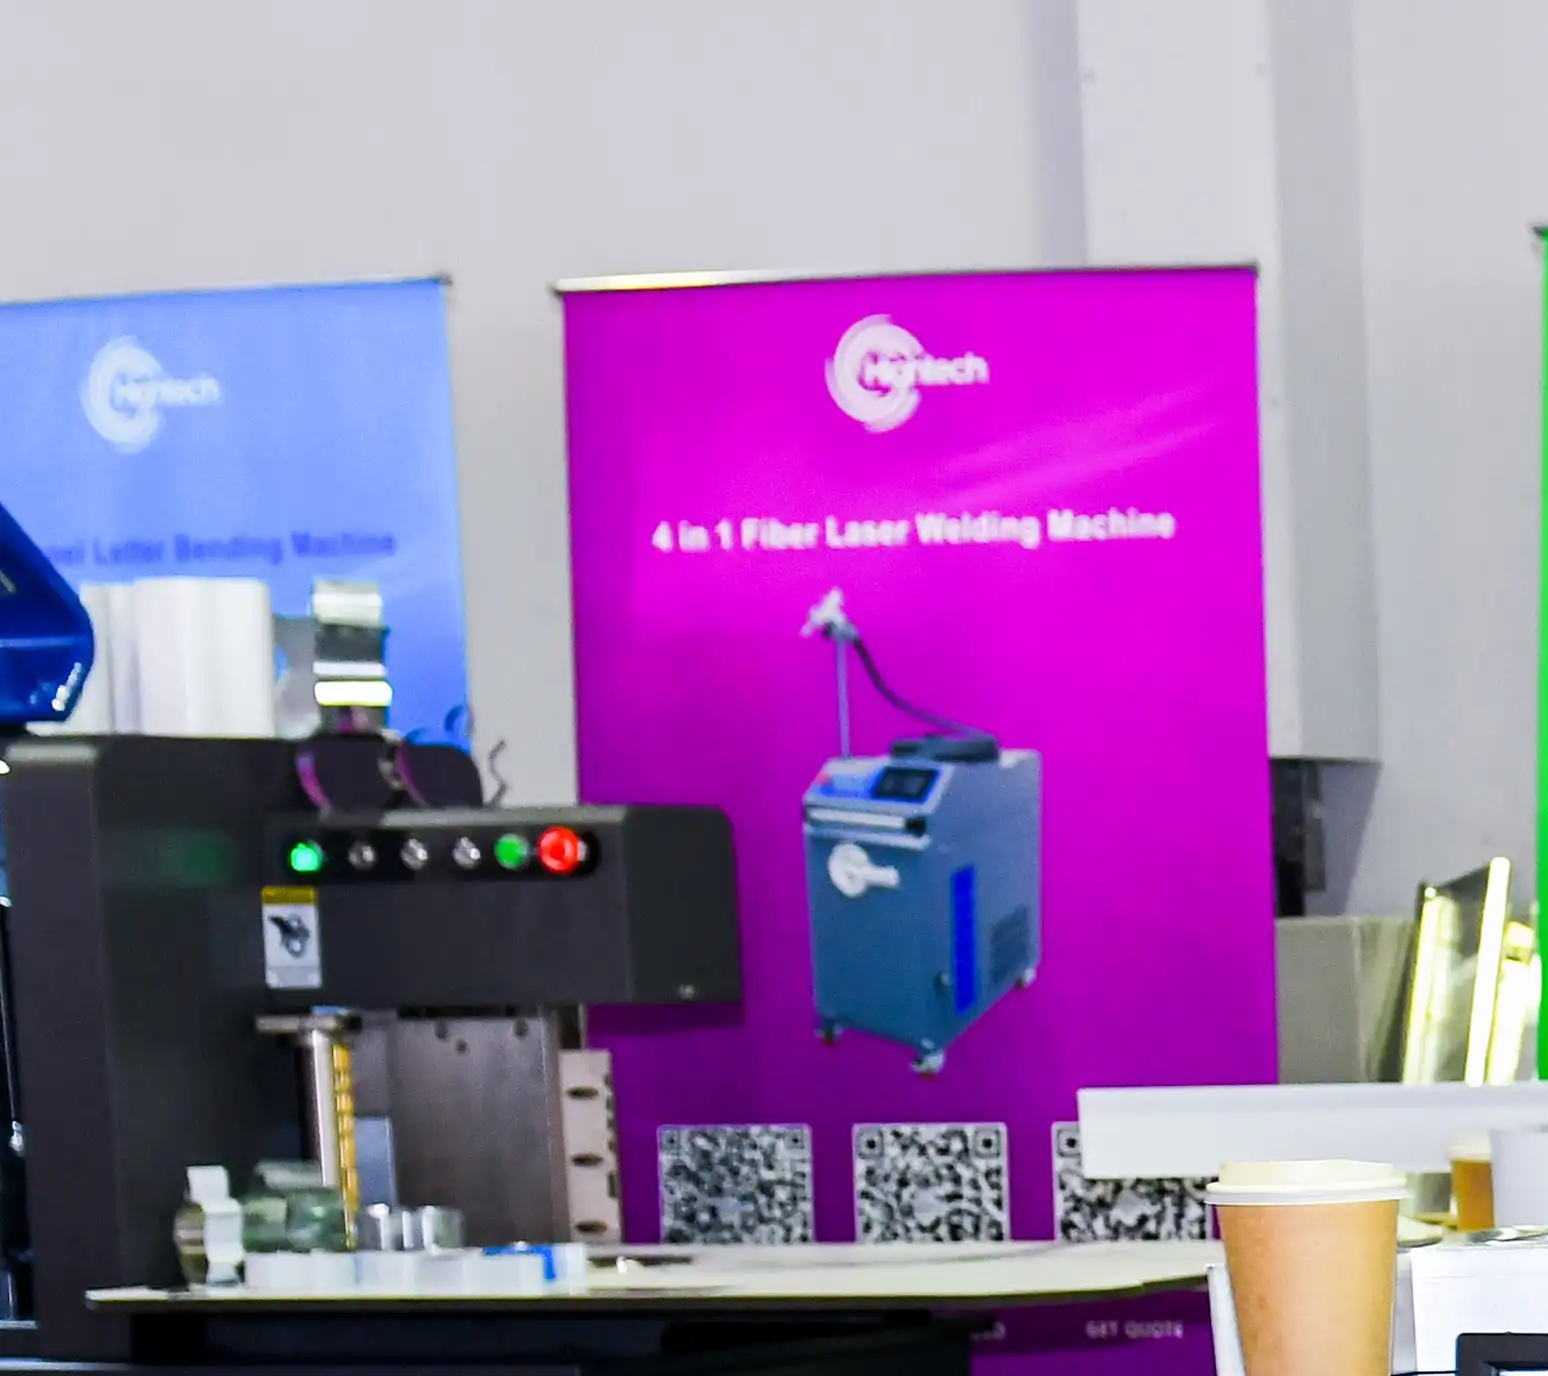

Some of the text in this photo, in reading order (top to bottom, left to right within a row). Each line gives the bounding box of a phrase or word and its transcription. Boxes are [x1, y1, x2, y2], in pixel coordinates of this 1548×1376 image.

[652, 522, 673, 552] 4
[678, 521, 710, 551] in
[741, 517, 819, 549] Fiber
[825, 516, 909, 548] Laser
[915, 513, 1040, 549] Welding
[1047, 508, 1176, 541] Machine
